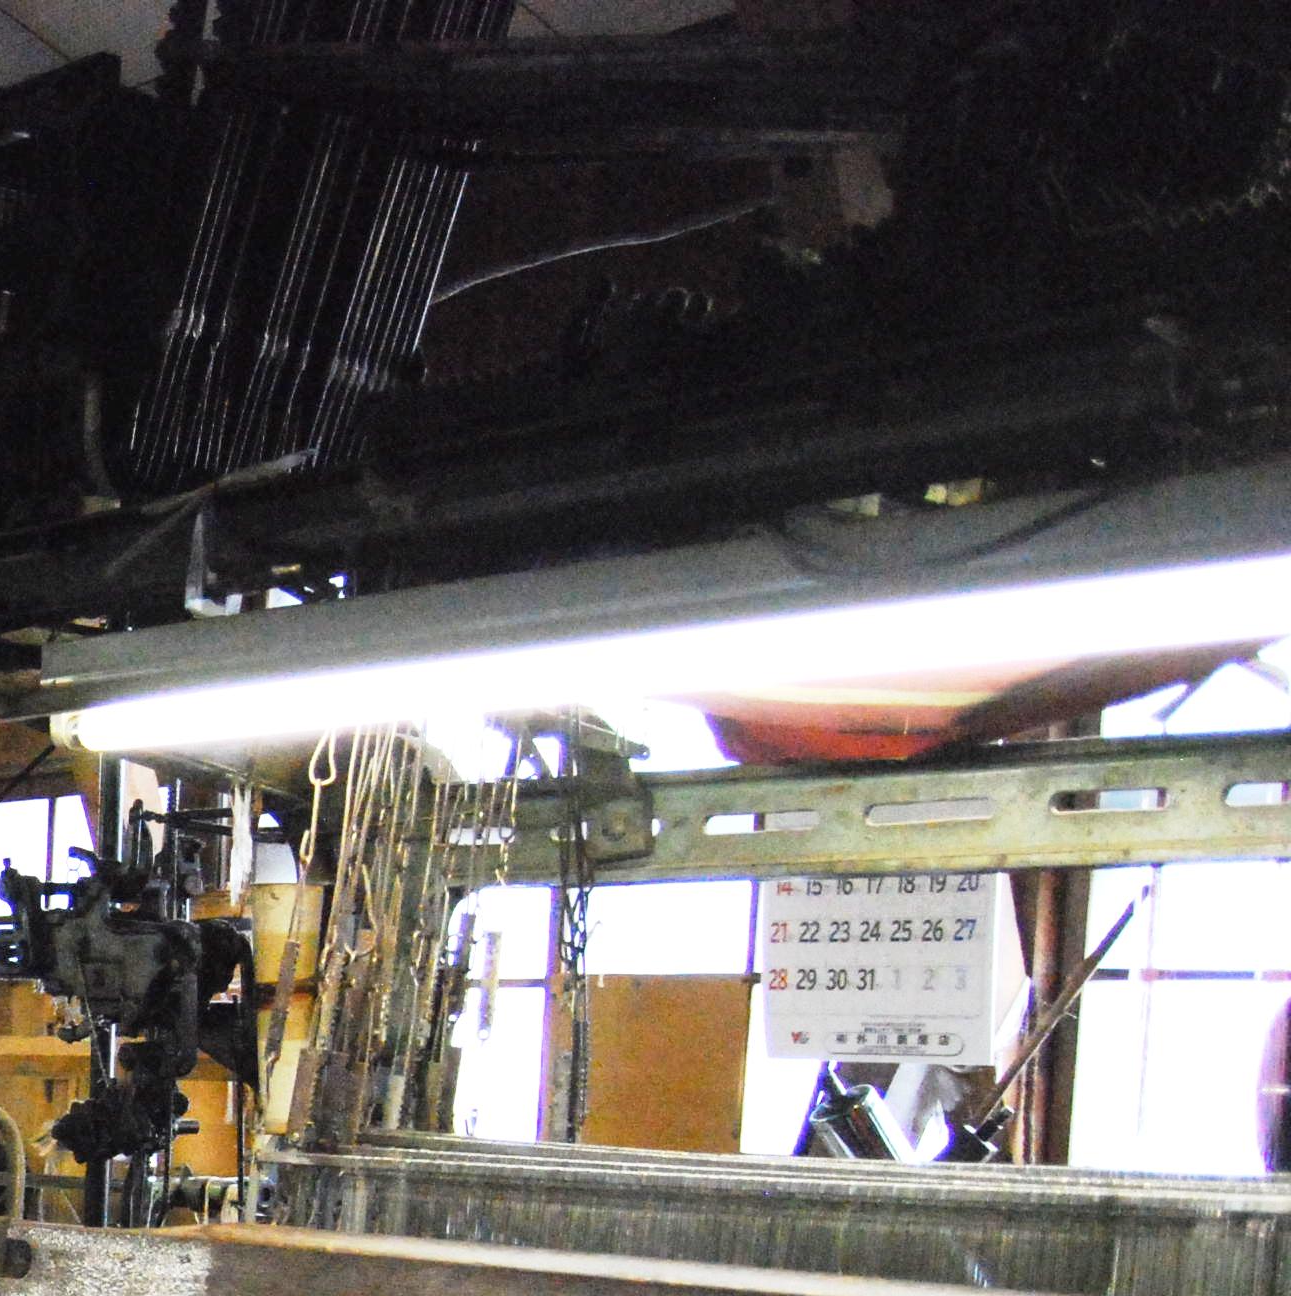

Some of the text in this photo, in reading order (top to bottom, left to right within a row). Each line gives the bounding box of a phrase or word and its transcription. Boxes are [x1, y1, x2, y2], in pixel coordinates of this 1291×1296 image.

[806, 880, 822, 896] 15
[836, 879, 853, 895] 16
[868, 878, 884, 895] 17
[898, 877, 915, 894] 18
[929, 876, 947, 892] 19
[957, 875, 980, 892] 20
[770, 918, 977, 943] 21 22 23 24 25 26 27
[768, 968, 968, 991] 28 29 30 31 1 2 3
